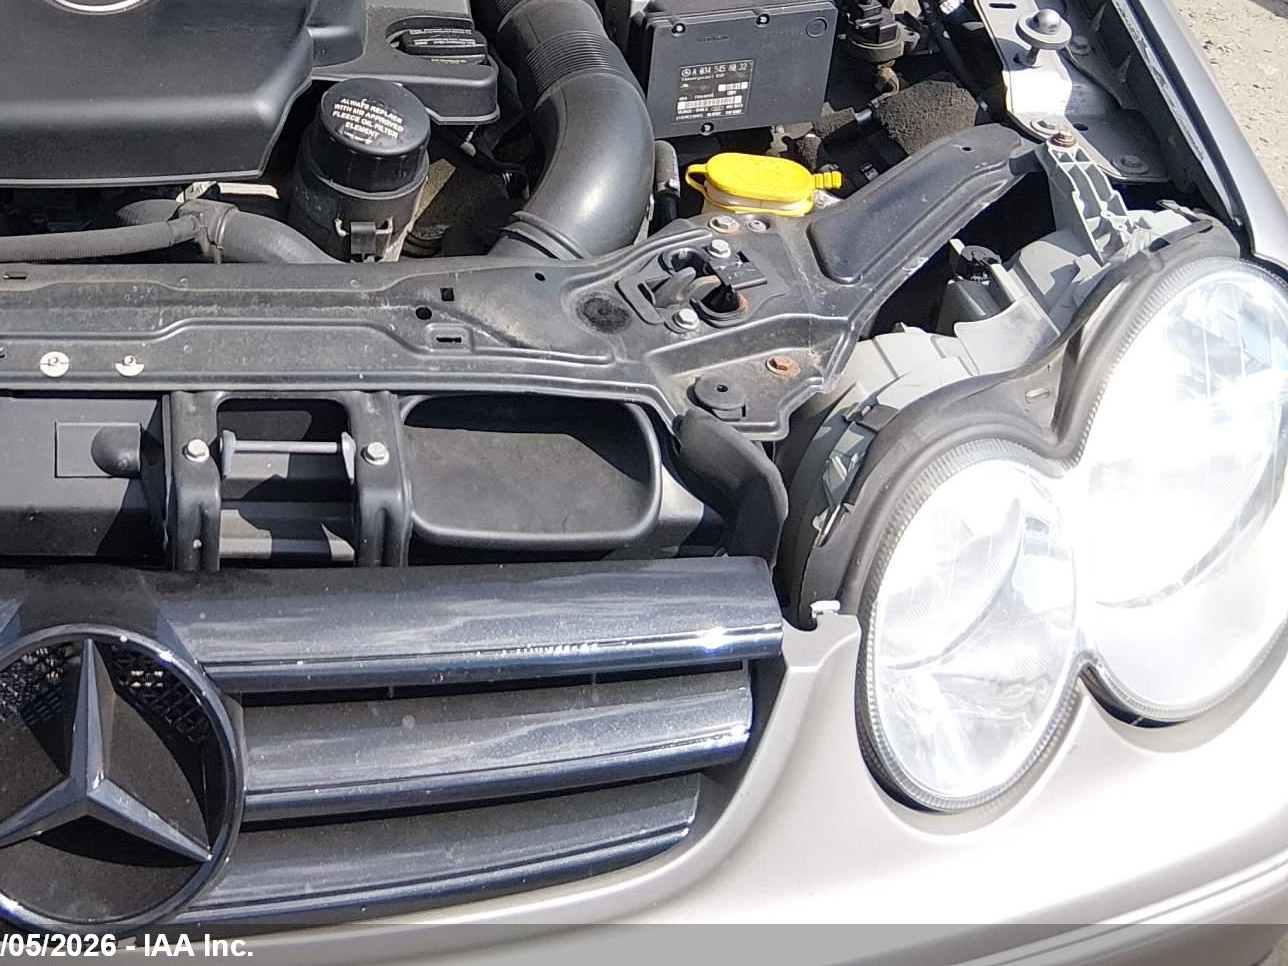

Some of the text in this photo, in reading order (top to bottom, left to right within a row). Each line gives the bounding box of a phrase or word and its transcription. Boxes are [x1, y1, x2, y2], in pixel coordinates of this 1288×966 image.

[332, 110, 361, 123] FLEECE
[361, 118, 373, 128] OIL
[374, 122, 399, 139] FILTER
[334, 103, 404, 132] WITH MB APPROVED
[340, 98, 403, 124] ALWAYS REPLACE
[345, 121, 380, 139] ELEMENT
